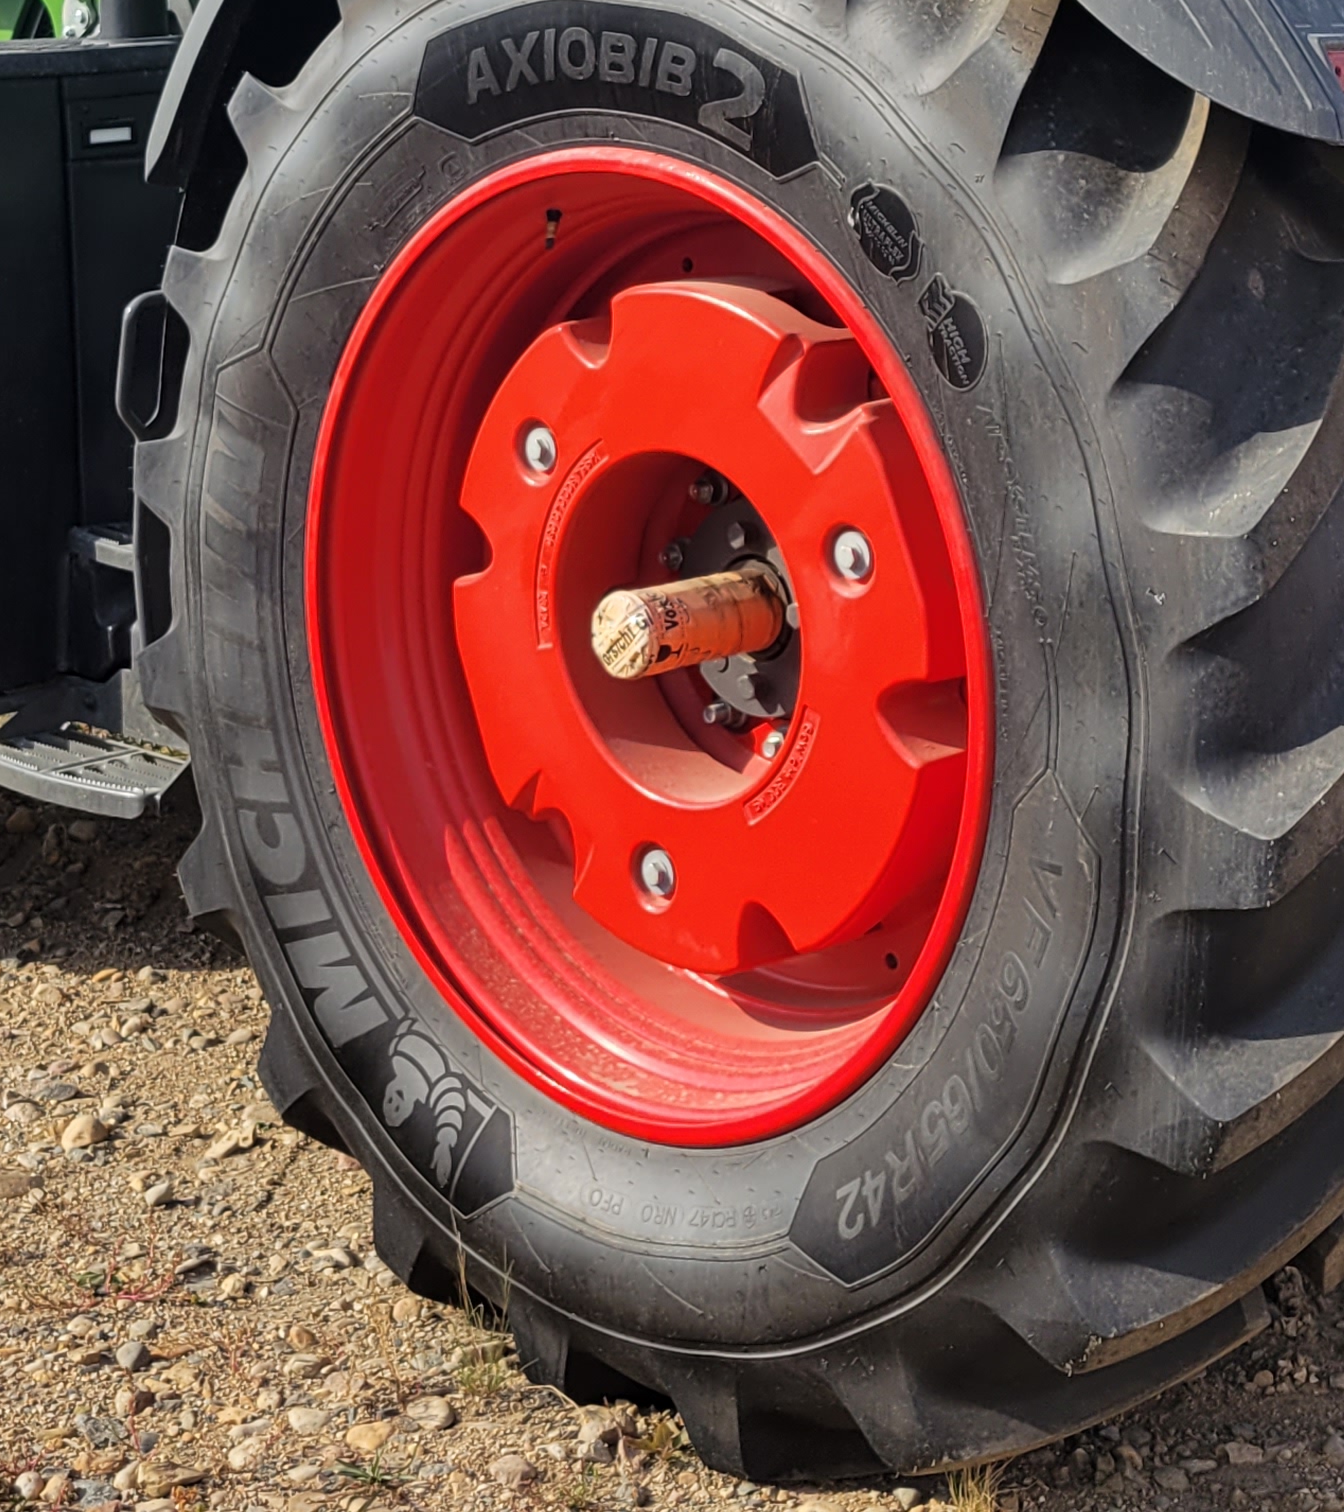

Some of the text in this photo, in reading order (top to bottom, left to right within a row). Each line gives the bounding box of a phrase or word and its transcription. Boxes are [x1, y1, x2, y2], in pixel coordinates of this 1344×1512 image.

[466, 26, 767, 151] AXIOBIB 2
[866, 200, 908, 249] MICHELIN
[937, 324, 970, 386] TRACTION
[942, 317, 972, 365] HIGH
[202, 402, 391, 1050] MICHELIN
